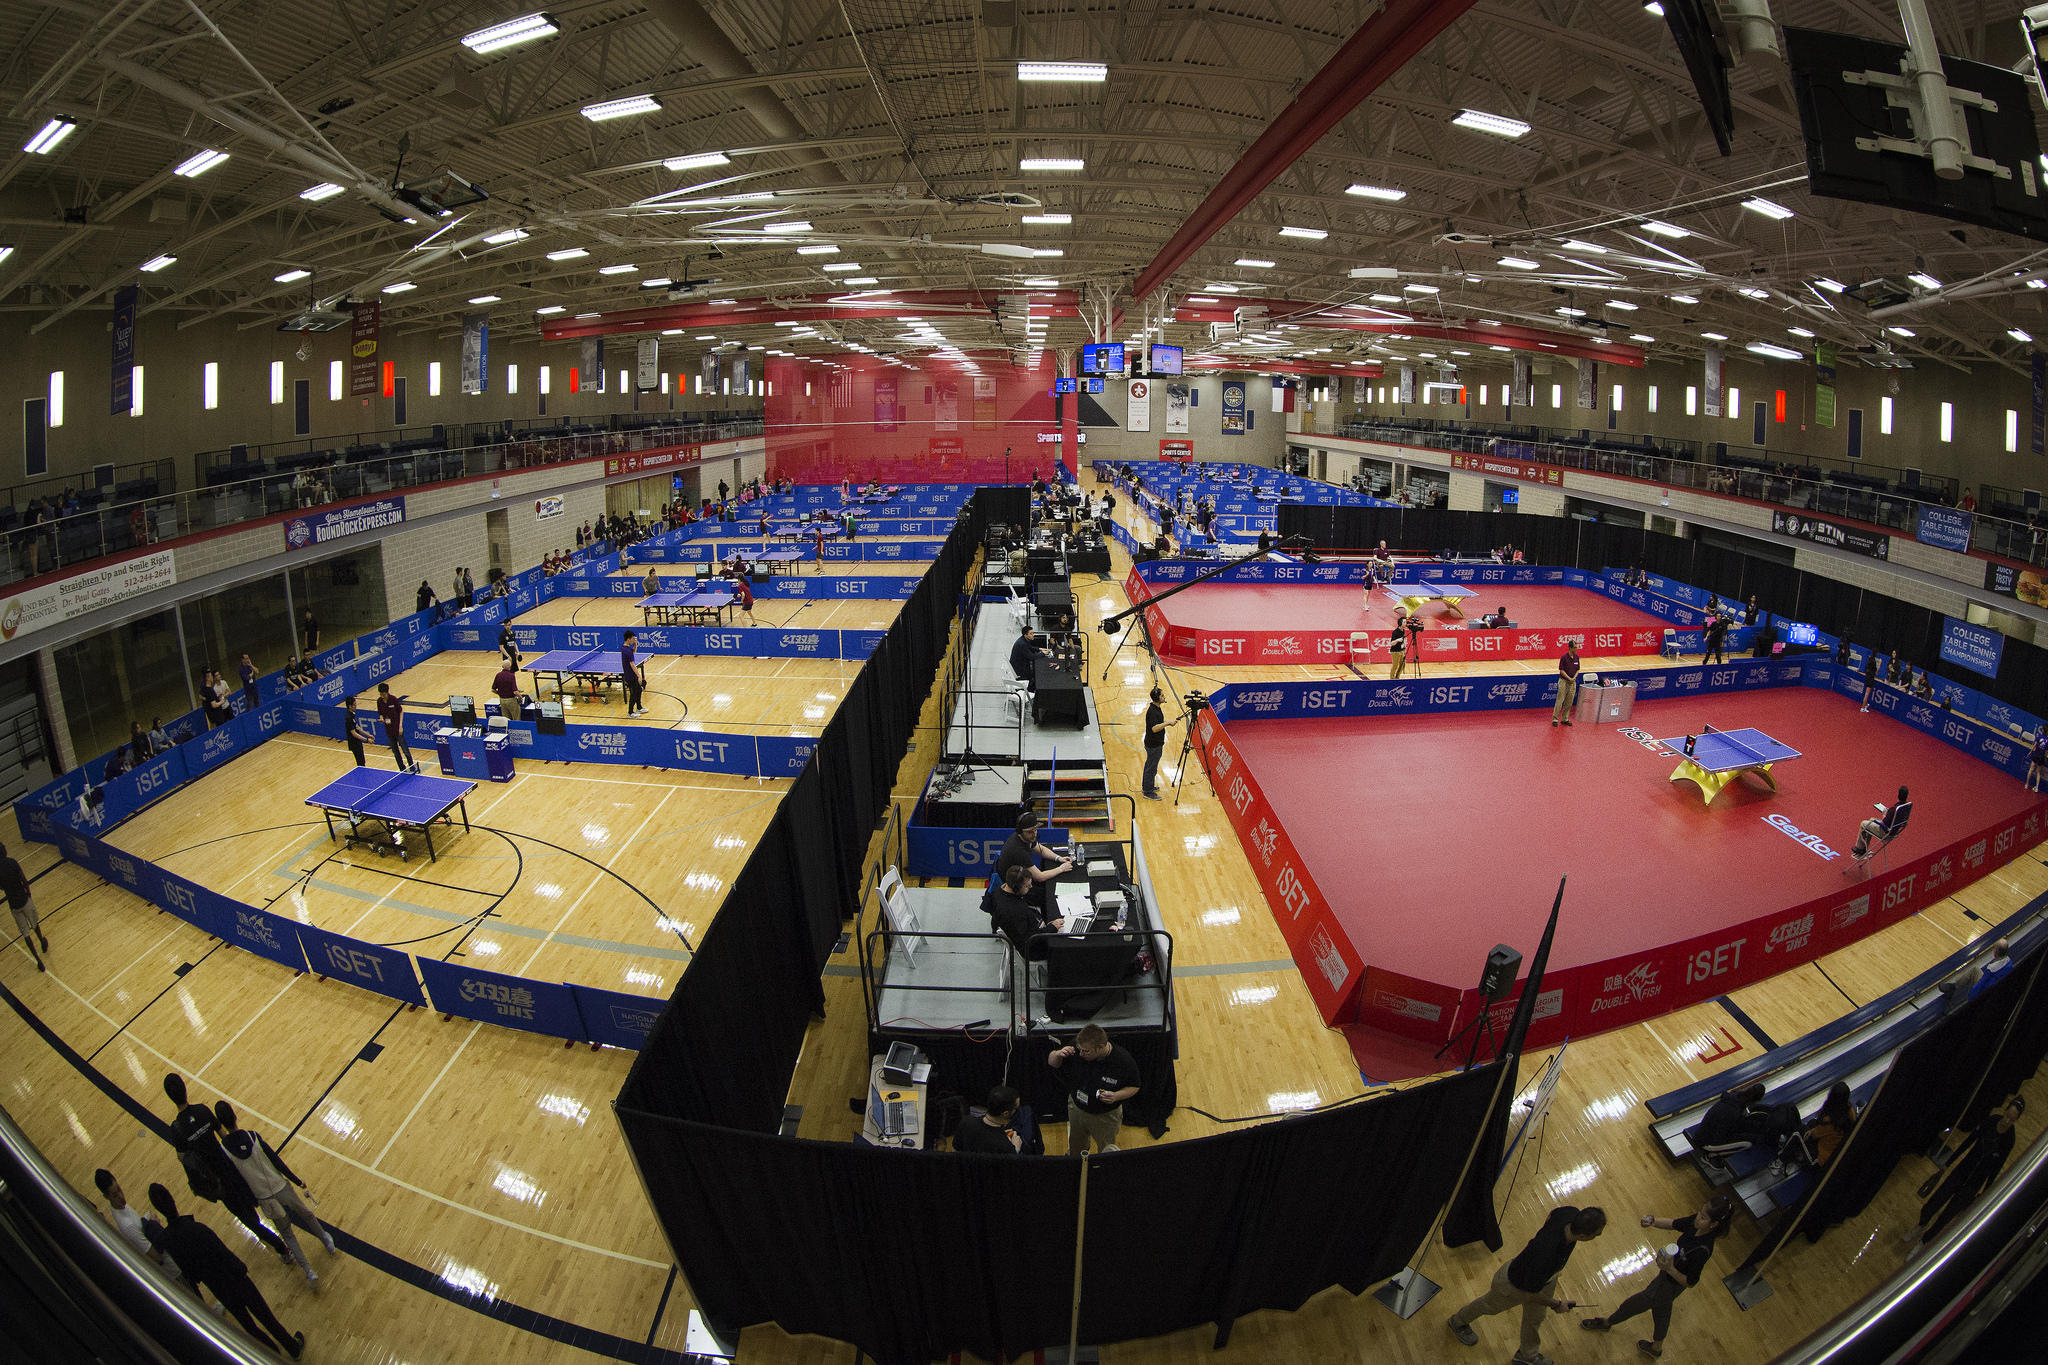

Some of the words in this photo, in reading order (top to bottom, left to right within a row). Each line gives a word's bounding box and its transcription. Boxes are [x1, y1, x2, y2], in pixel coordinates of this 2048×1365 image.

[355, 343, 375, 353] Denny's
[343, 505, 376, 519] Hometown
[376, 501, 393, 512] Team
[1928, 511, 1963, 526] COLLEGE
[739, 525, 759, 534] iSET
[900, 523, 922, 532] iSET
[1801, 521, 1845, 543] AUSTIN
[1920, 519, 1942, 531] TABLE
[1944, 524, 1969, 537] TENNIS
[1815, 534, 1838, 546] BASKETBALL
[1921, 529, 1966, 546] CHAMPIONSHIPS
[825, 546, 850, 556] iSET
[59, 575, 100, 595] Straighten
[101, 570, 112, 582] Up
[113, 566, 128, 578] and
[129, 561, 149, 573] Smile
[150, 554, 170, 568] Right
[1274, 567, 1303, 579] iSET
[1482, 570, 1506, 580] iSET
[612, 581, 638, 593] iSET
[836, 581, 867, 593] iSET
[1608, 584, 1625, 598] iSET
[62, 598, 73, 609] Dr.
[74, 592, 90, 604] Paul
[1652, 600, 1669, 614] iSET
[483, 604, 500, 625] iSET
[568, 632, 601, 647] iSET
[705, 634, 743, 649] iSET
[1469, 636, 1503, 651] iSET
[1595, 634, 1623, 648] iSET
[1790, 630, 1797, 639] 11
[1807, 633, 1816, 642] 10
[1952, 626, 1991, 647] COLLEGE
[1204, 638, 1246, 655] iSET
[1262, 646, 1284, 656] DOUBLE
[1317, 638, 1354, 654] iSET
[1944, 634, 1968, 651] TABLE
[1969, 643, 1997, 661] TENNIS
[1943, 646, 1993, 670] CHAMPIONSHIPS
[368, 655, 393, 680] iSET
[1711, 671, 1738, 687] iSET
[1302, 689, 1351, 709] iSET
[1368, 699, 1393, 708] DOUBLE
[1429, 686, 1474, 704] iSET
[1871, 688, 1899, 711] iSET
[259, 705, 283, 732] iSE
[1943, 719, 1974, 745] iSET
[600, 746, 627, 756] DHS
[676, 739, 729, 763] iSET
[136, 760, 170, 796] iSET
[1229, 772, 1254, 817] iSET
[1767, 813, 1841, 860] Gerflor
[1994, 826, 2016, 857] iSET
[950, 840, 998, 866] iSE
[162, 879, 198, 915] iSET
[1276, 861, 1310, 921] iSET
[1882, 873, 1917, 912] iSET
[324, 942, 385, 983] iSET
[1686, 938, 1747, 985] iSET
[1591, 993, 1630, 1013] DOUBLE
[1642, 985, 1662, 999] FISH
[497, 1002, 537, 1020] DHS
